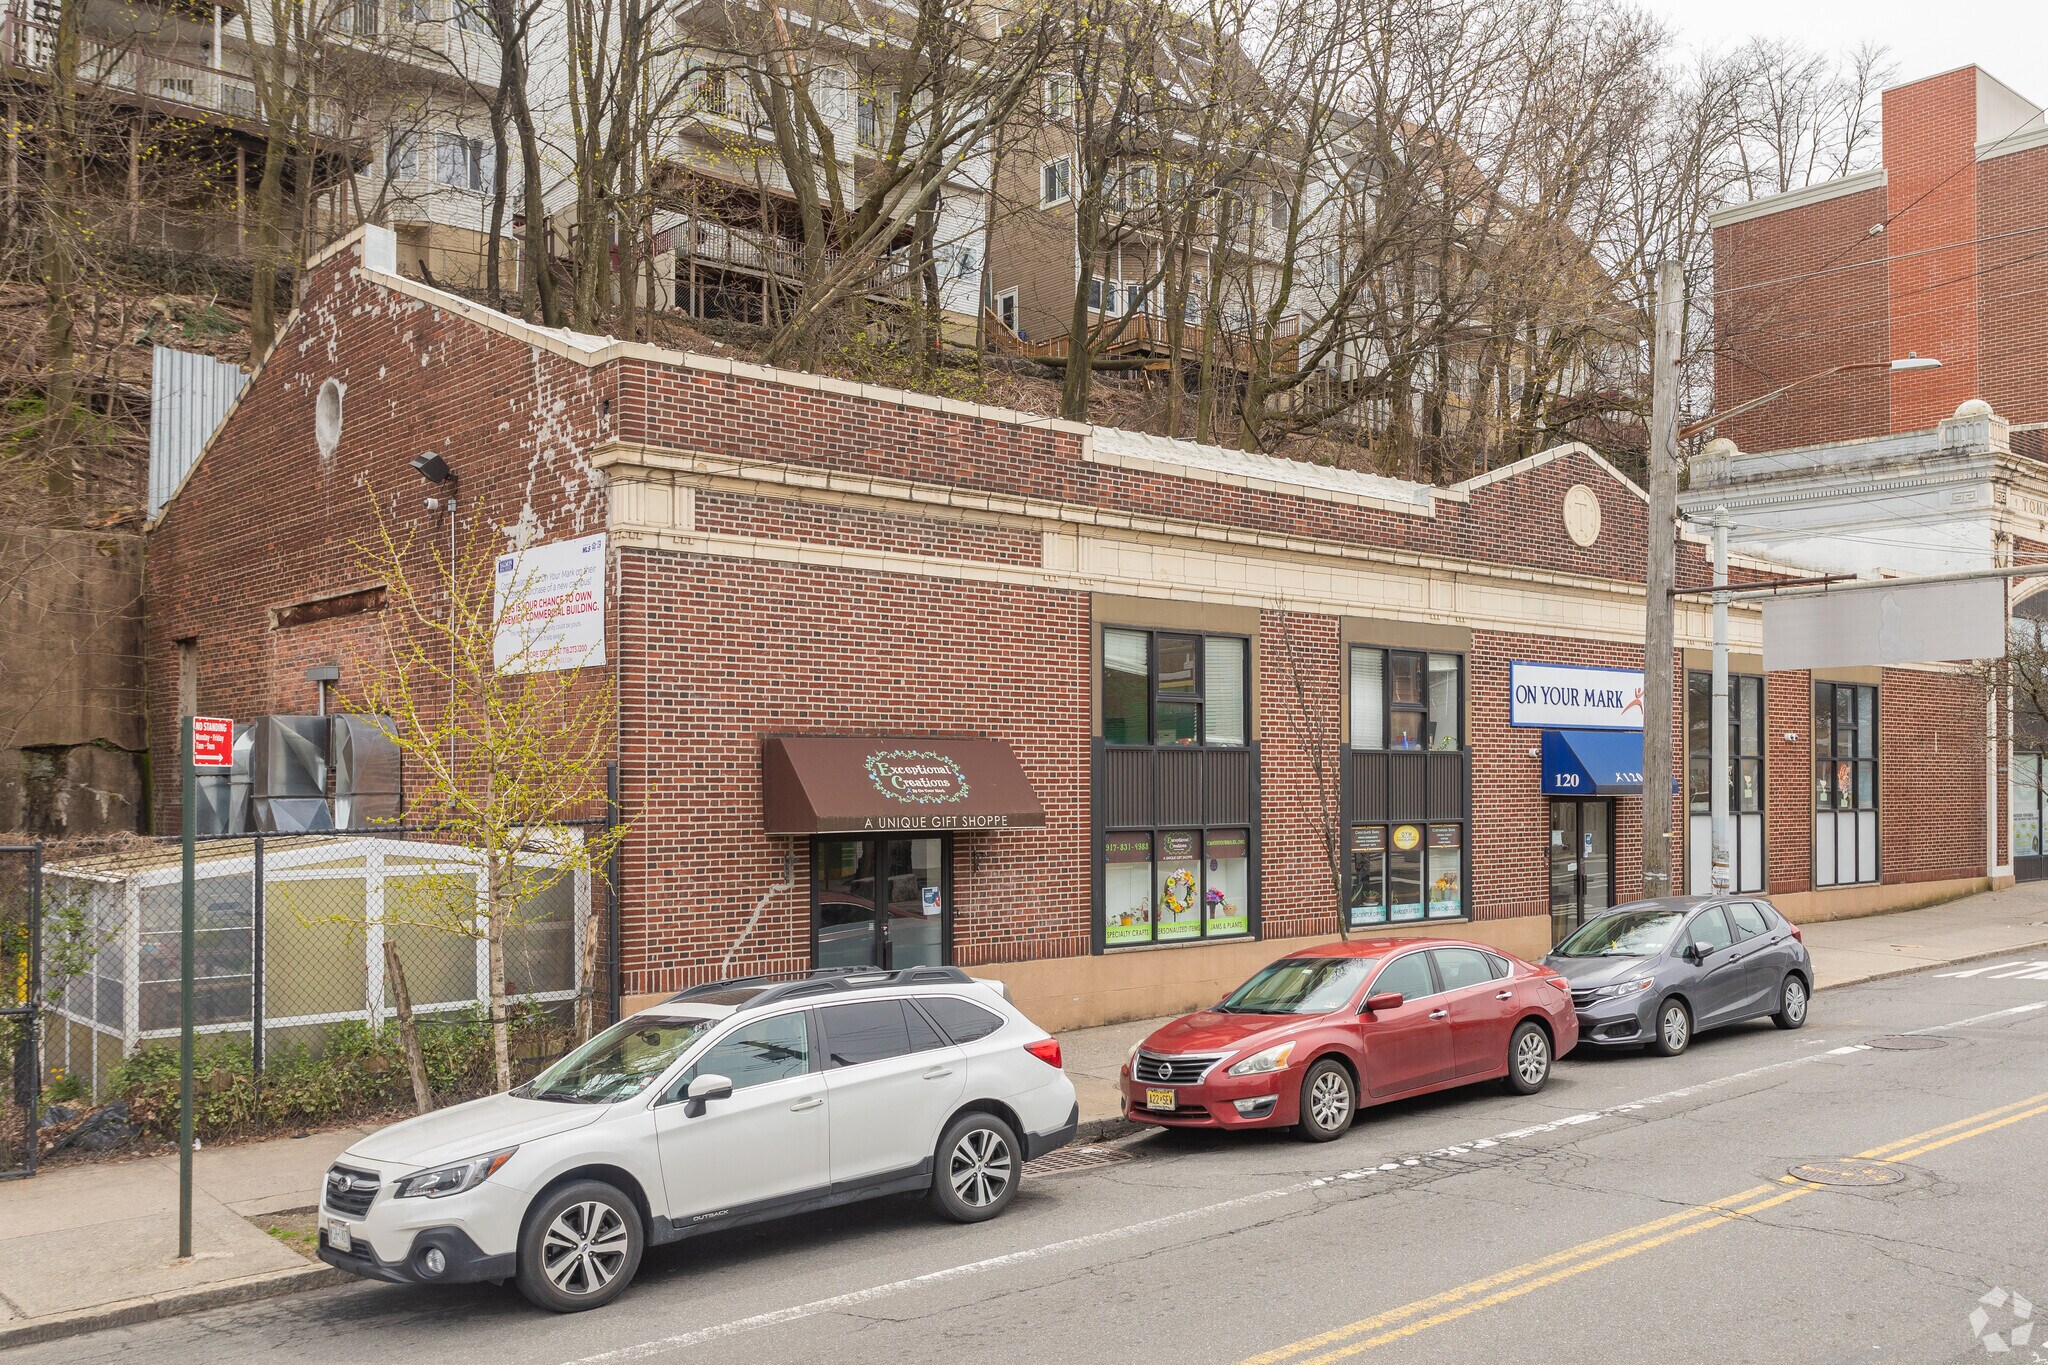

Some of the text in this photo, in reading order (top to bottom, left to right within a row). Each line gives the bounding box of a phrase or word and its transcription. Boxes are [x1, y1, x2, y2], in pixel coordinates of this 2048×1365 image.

[549, 571, 560, 581] Your
[562, 568, 575, 579] Mark
[547, 585, 553, 593] of
[557, 582, 568, 590] new
[539, 595, 563, 608] CHANCE
[575, 591, 592, 602] OWN
[566, 602, 599, 616] BUILDING.
[1515, 684, 1624, 709] ON YOUR MARK
[195, 722, 227, 732] NO STANDING
[876, 762, 952, 776] Exceptional
[891, 775, 951, 790] Creations
[1555, 773, 1580, 788] 120
[864, 815, 1008, 829] A UNIQUE GIFT SHOPPE
[1393, 907, 1420, 915] HANDCRAFTED
[1157, 926, 1187, 935] ERSONALIZED
[1210, 922, 1223, 930] JAMS
[1227, 921, 1243, 929] PLANTS
[1106, 929, 1150, 939] SPECIALTY CRAFTS
[692, 1209, 729, 1222] OUTBACK
